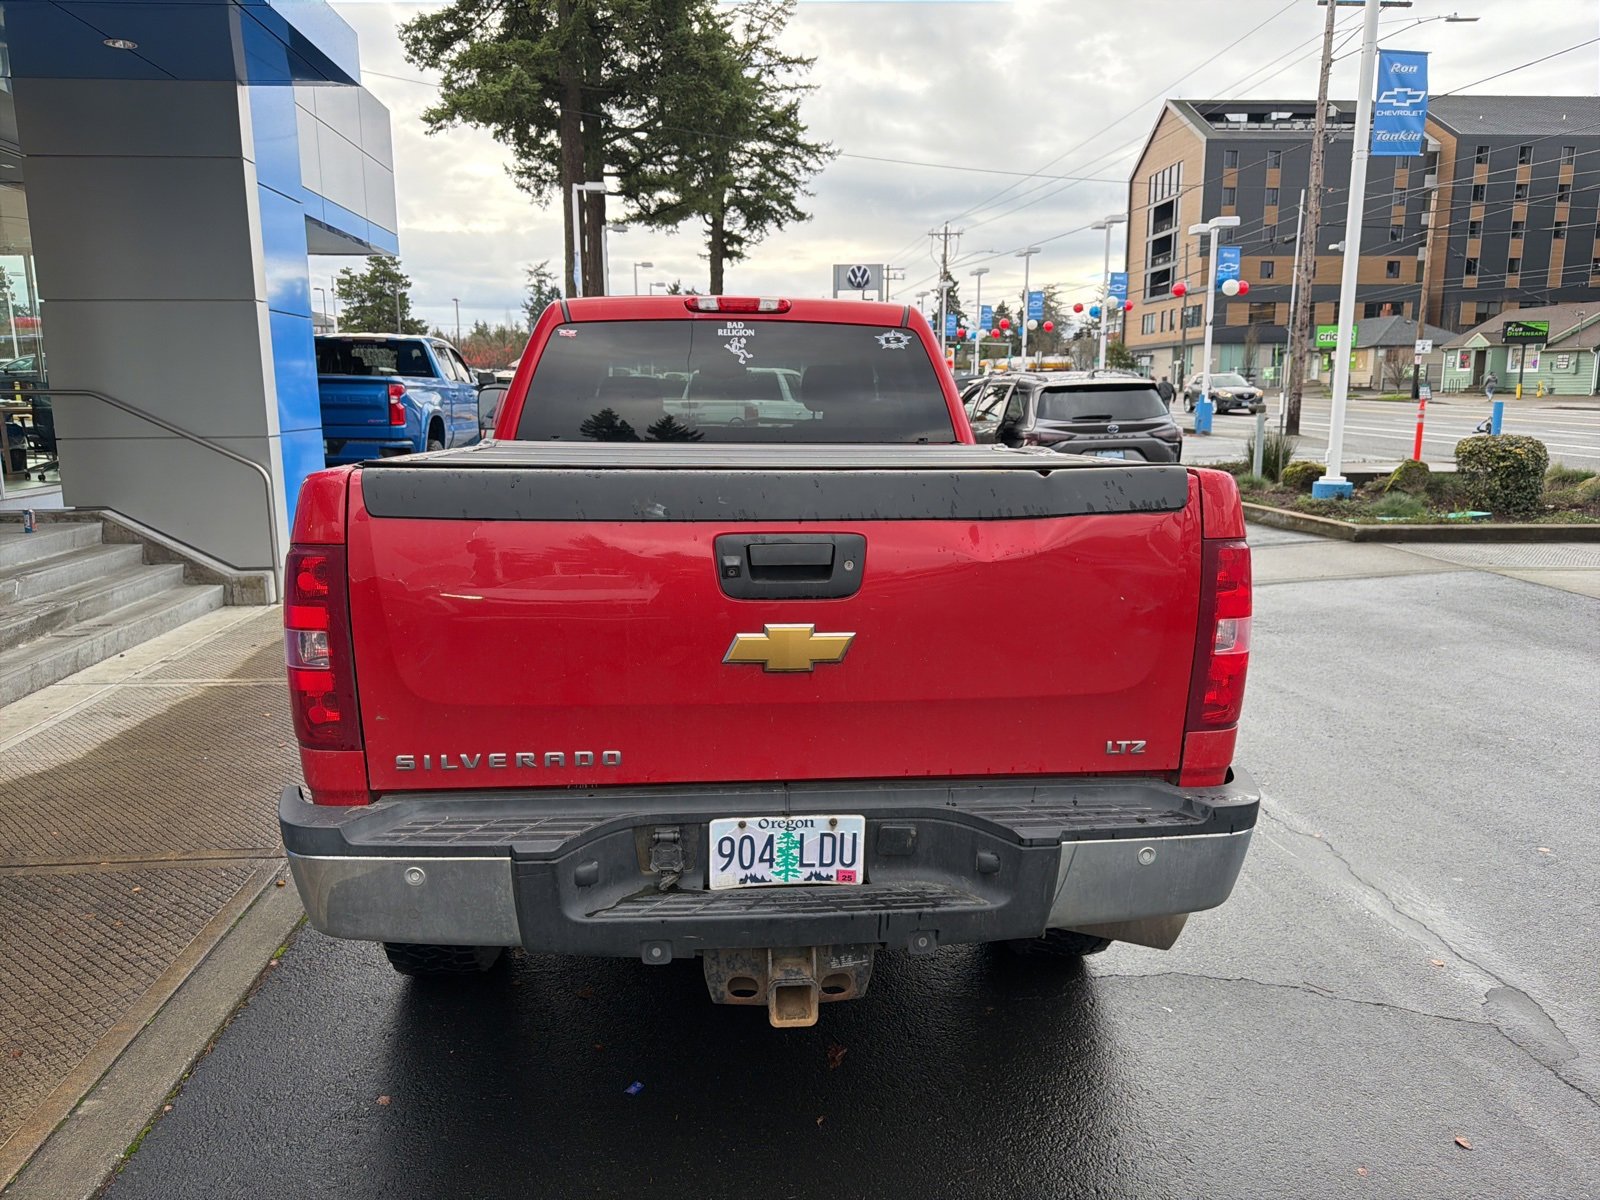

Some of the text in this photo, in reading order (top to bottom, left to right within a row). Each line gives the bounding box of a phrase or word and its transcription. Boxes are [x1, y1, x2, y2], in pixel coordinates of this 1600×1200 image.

[1390, 63, 1418, 73] Ron
[726, 321, 745, 329] BAD
[717, 328, 755, 337] RELIGION
[1106, 740, 1147, 754] LTZ
[395, 750, 622, 770] SILVERADO
[758, 818, 815, 832] Oregon
[717, 832, 857, 872] 904 LDU
[841, 874, 853, 882] 25
